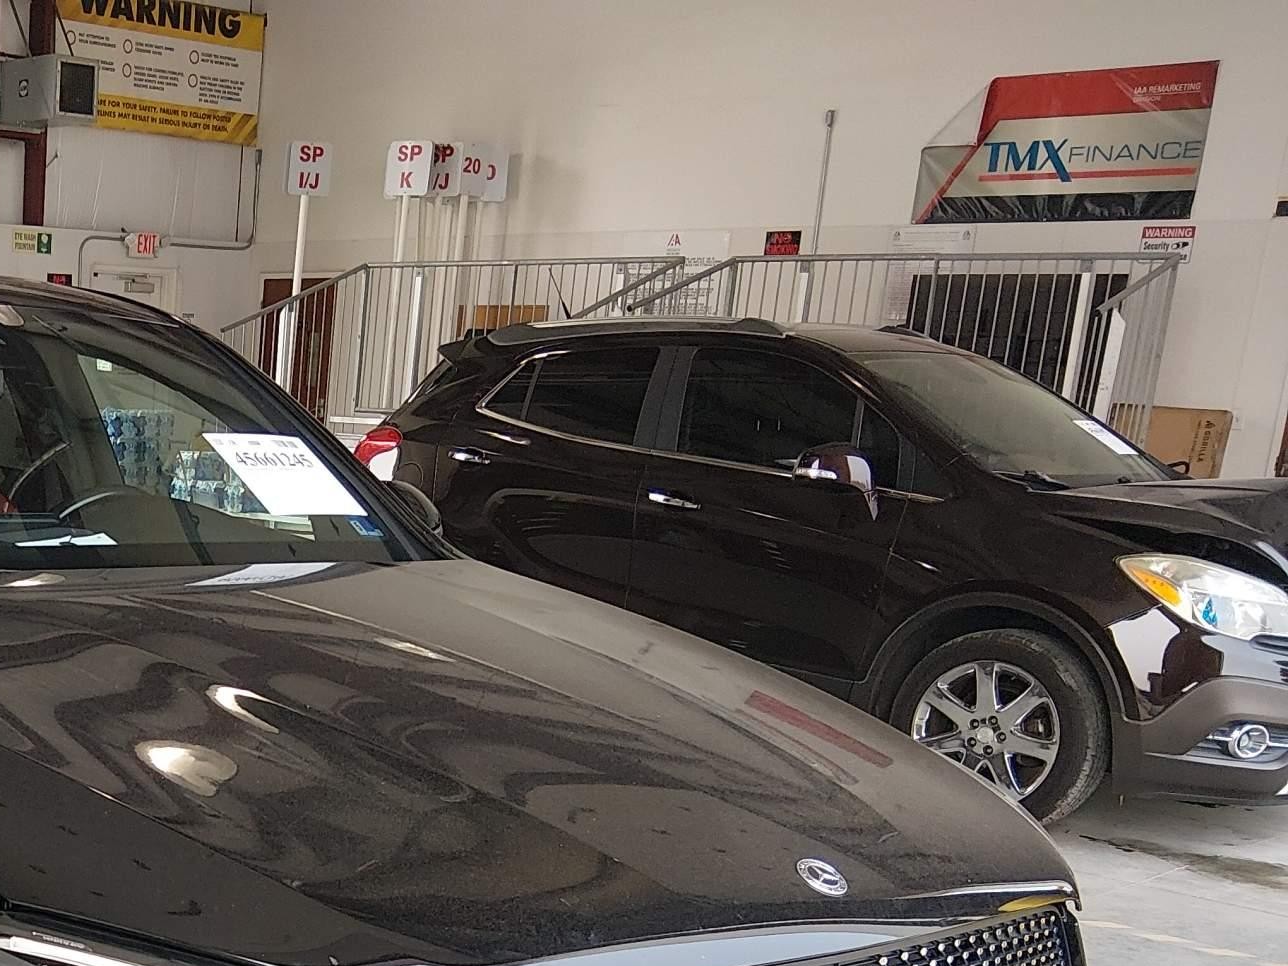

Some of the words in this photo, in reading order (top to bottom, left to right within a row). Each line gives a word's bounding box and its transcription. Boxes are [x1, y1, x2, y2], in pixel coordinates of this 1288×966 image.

[1148, 82, 1201, 94] REMARKETING
[108, 100, 121, 108] FOR
[122, 102, 137, 110] YOUR
[181, 109, 189, 117] TO
[190, 110, 211, 120] FOLLOW
[299, 145, 324, 163] SP
[398, 144, 422, 162] SP
[463, 157, 481, 174] 20
[399, 172, 413, 189] K
[1145, 227, 1193, 238] WARNING
[137, 234, 158, 254] EXIT
[235, 452, 315, 468] 45661245
